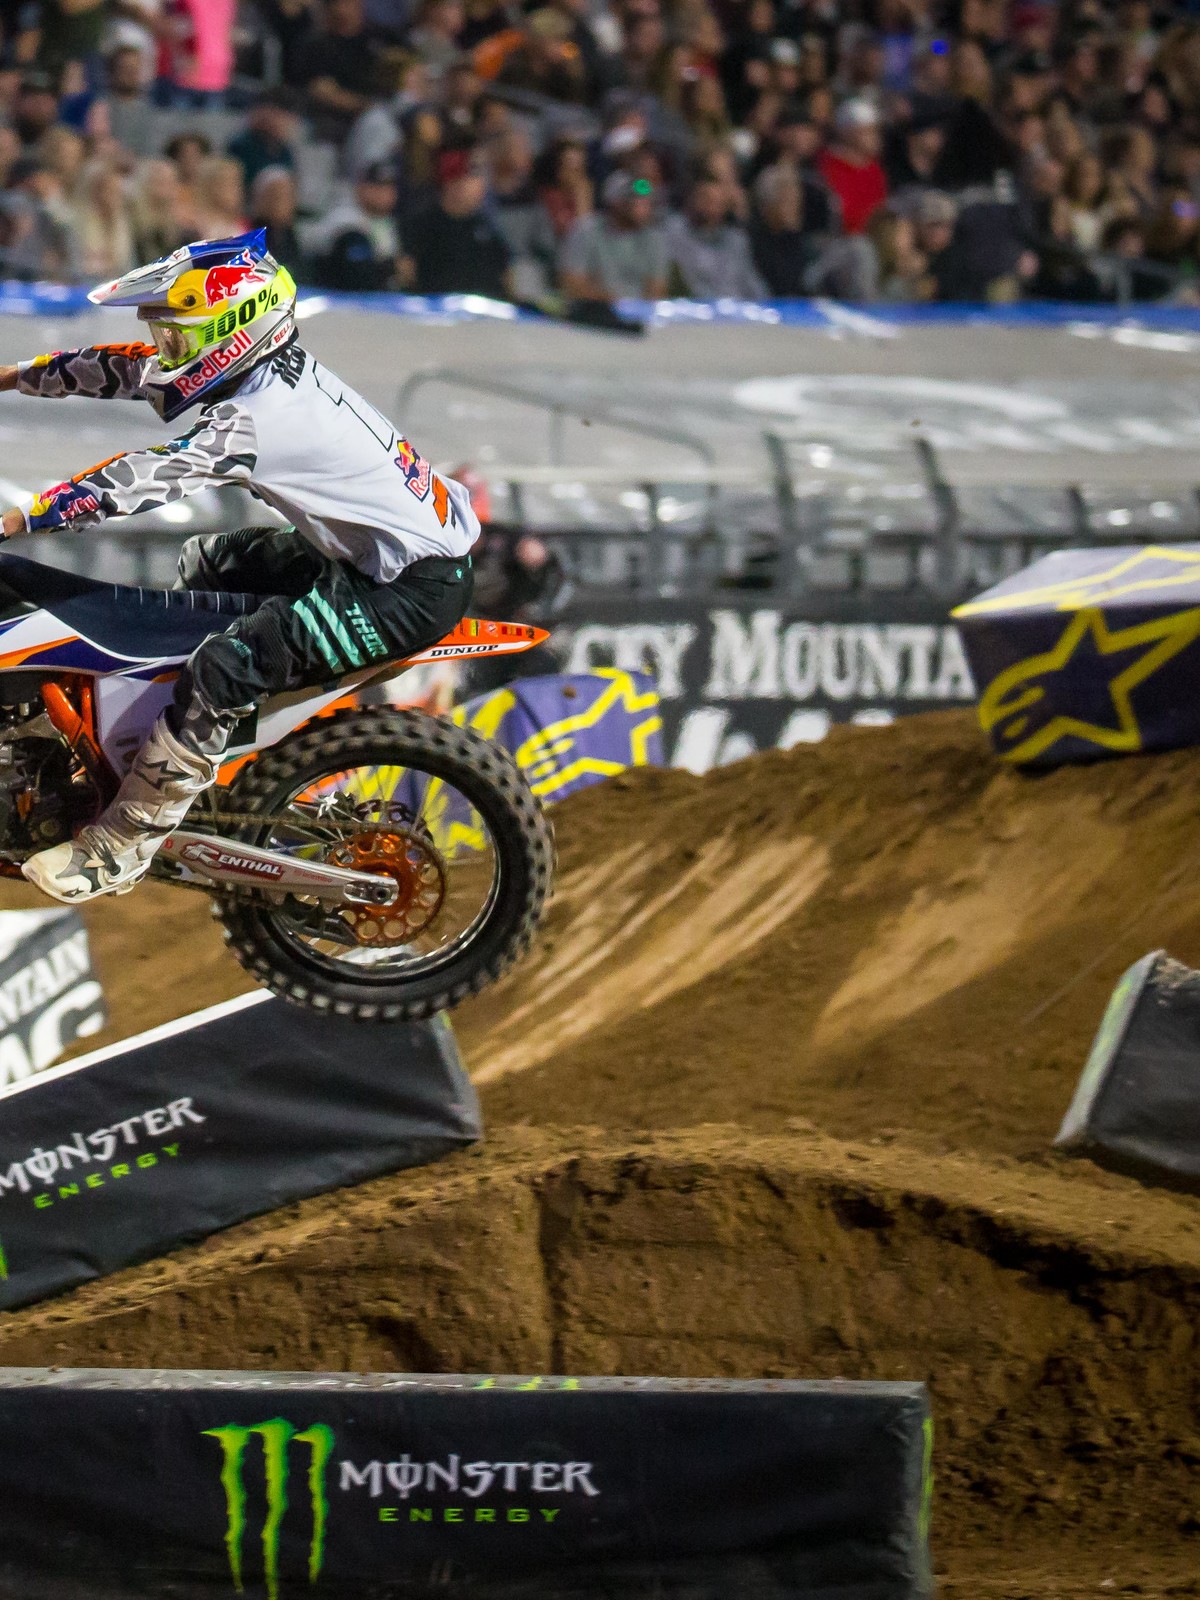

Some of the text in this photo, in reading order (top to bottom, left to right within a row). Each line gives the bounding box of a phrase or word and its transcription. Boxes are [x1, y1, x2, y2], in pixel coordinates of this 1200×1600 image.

[201, 283, 279, 345] 100%
[273, 323, 291, 344] BELL
[173, 355, 221, 398] Red
[210, 329, 253, 370] Bull
[430, 644, 499, 658] DUNLOP
[703, 609, 978, 699] MOUNTA
[31, 1142, 181, 1209] ENERGY
[338, 1453, 601, 1499] MONSTER
[377, 1507, 561, 1523] ENERGY
